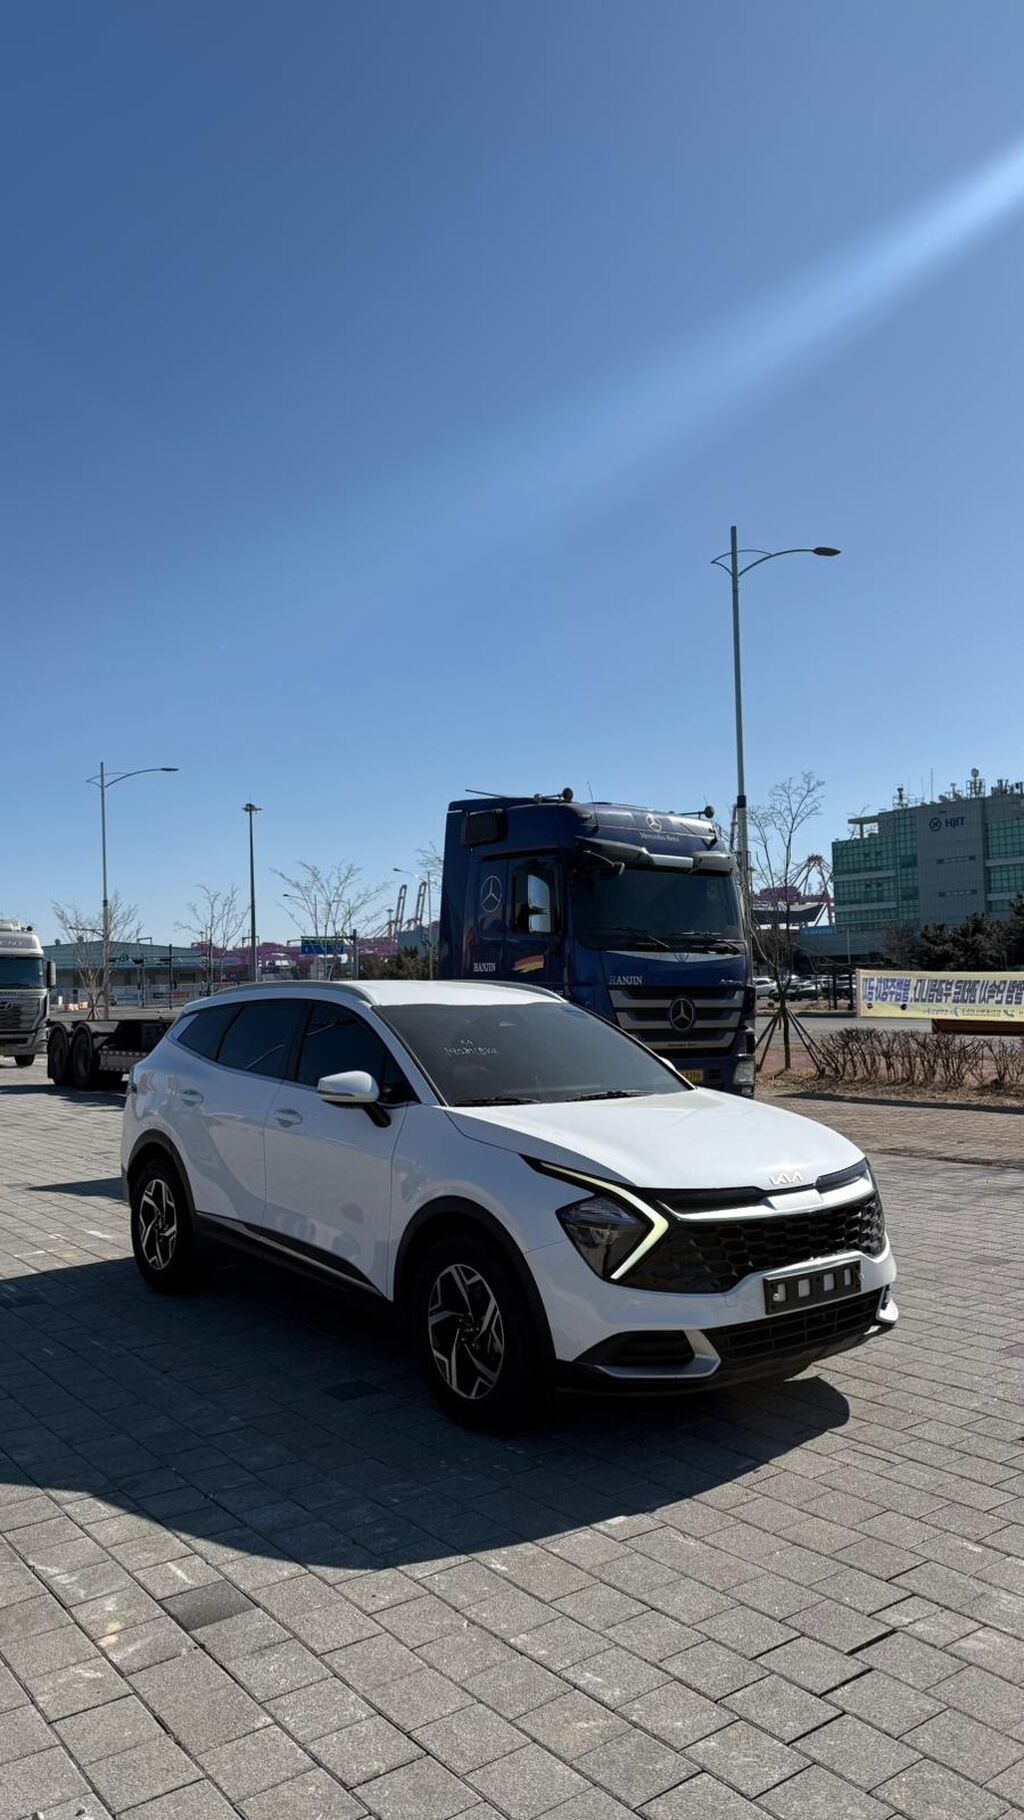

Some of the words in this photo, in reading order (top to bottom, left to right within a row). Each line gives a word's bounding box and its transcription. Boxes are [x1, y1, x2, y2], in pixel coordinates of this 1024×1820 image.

[945, 816, 966, 828] HJIT
[473, 963, 496, 973] HANJIN
[609, 976, 643, 986] HANJIN
